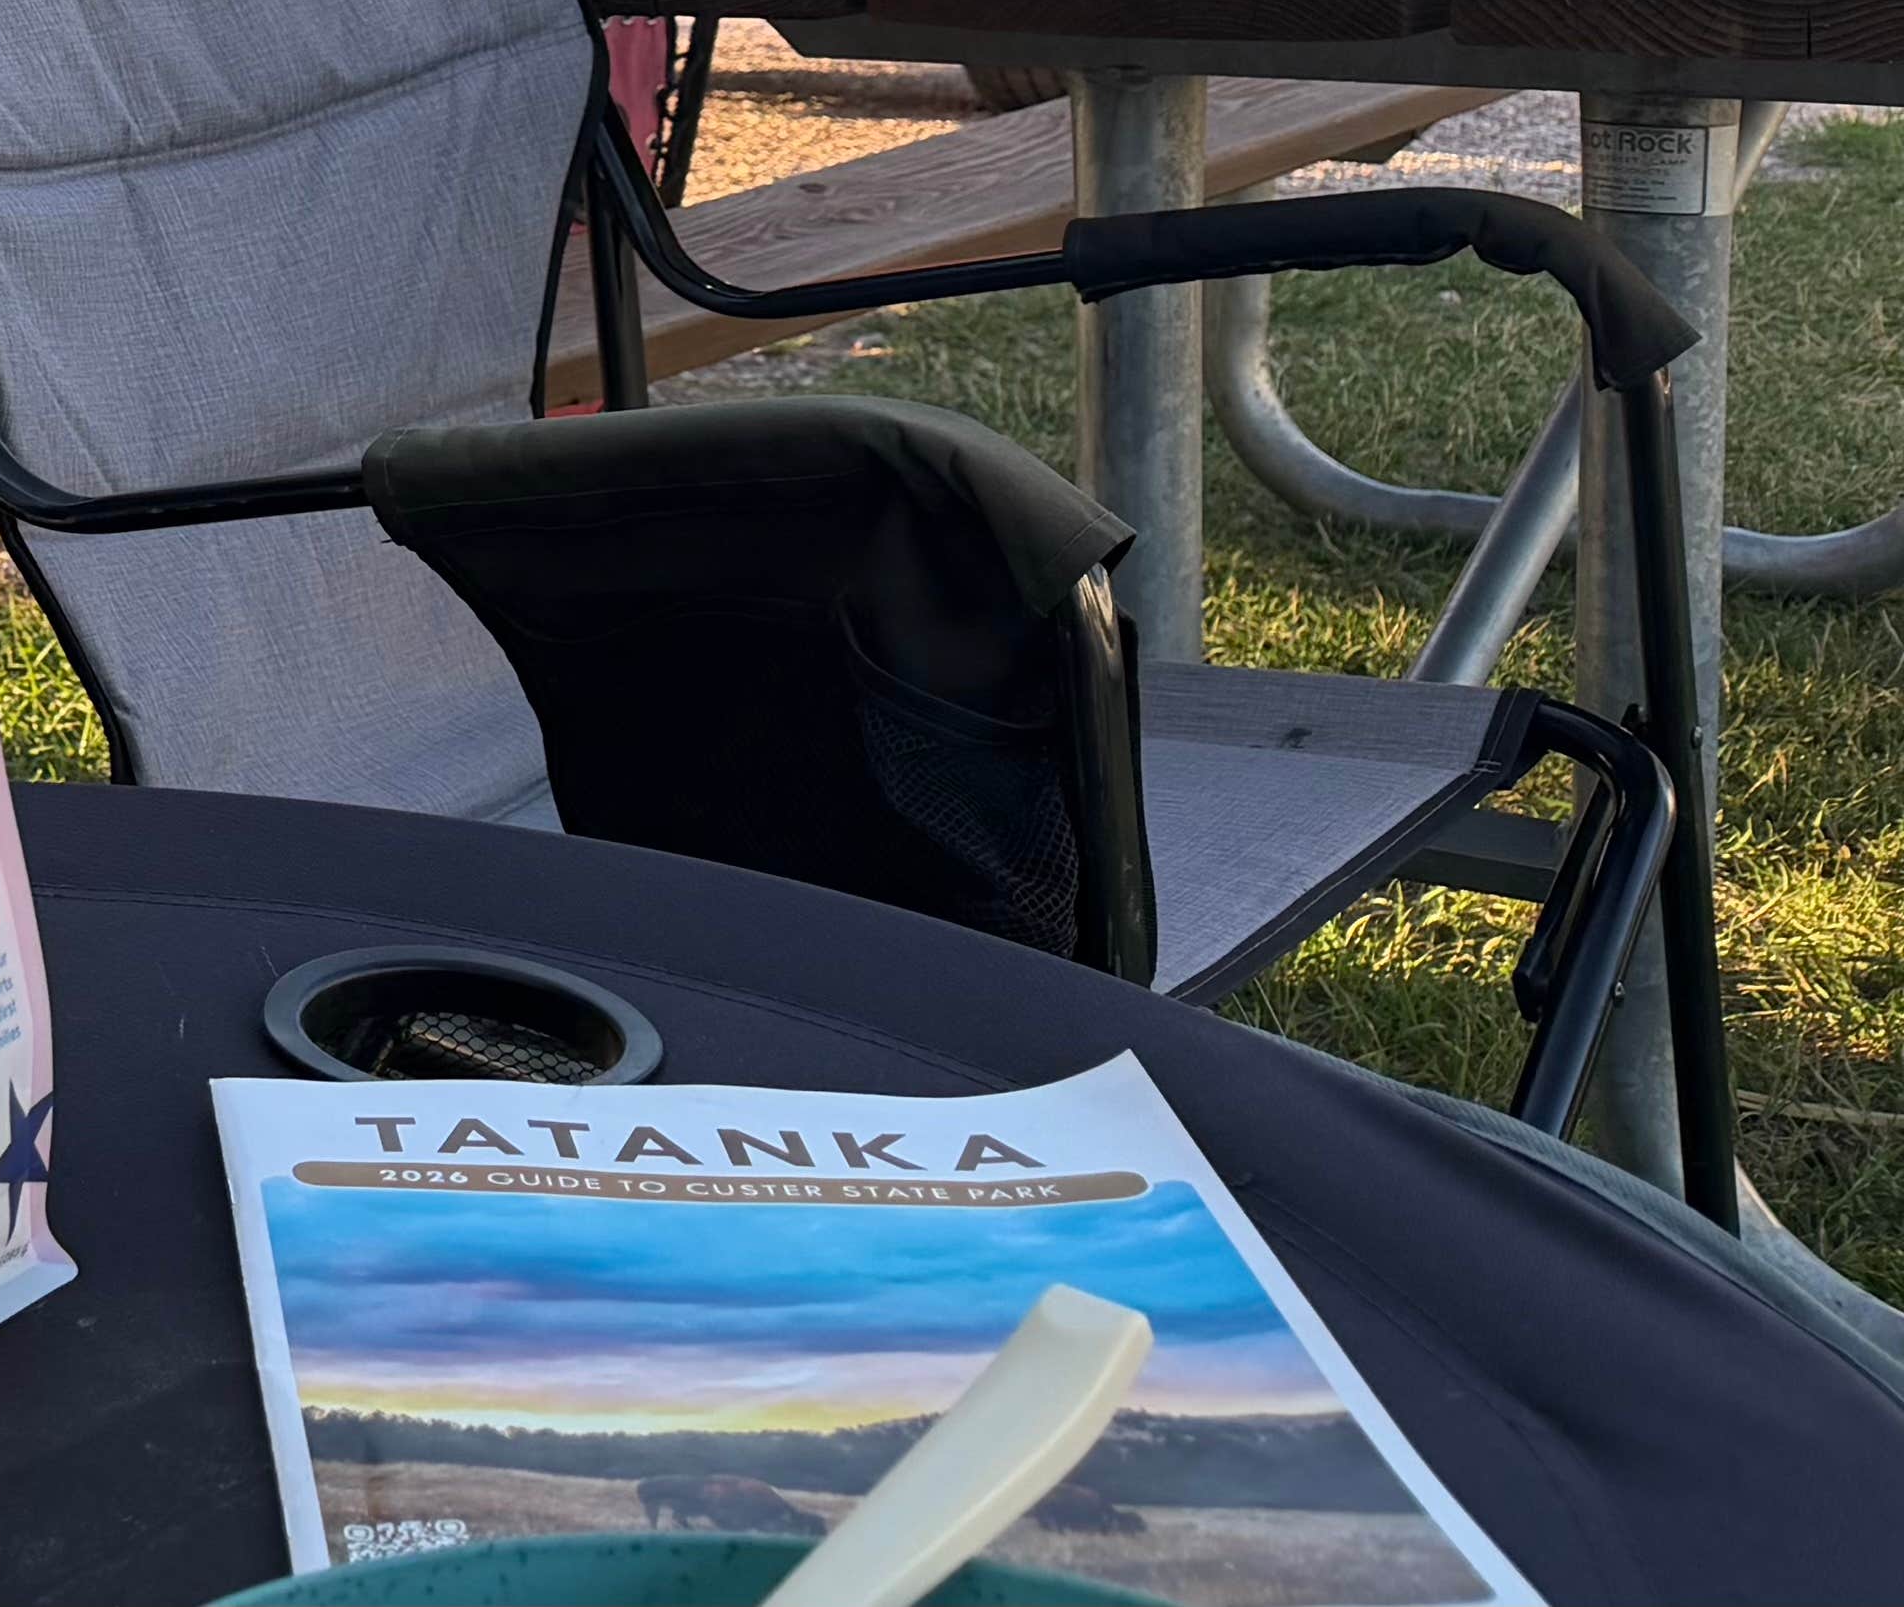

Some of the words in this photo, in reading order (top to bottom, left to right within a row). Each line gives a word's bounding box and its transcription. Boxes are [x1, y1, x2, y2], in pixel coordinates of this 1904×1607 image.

[354, 1116, 1047, 1172] TATANKA
[378, 1168, 469, 1185] 2026
[487, 1171, 602, 1191] GUIDE
[617, 1179, 668, 1194] TO
[685, 1181, 823, 1197] CUSTER
[842, 1184, 951, 1200] STATE
[968, 1183, 1064, 1201] PARK
